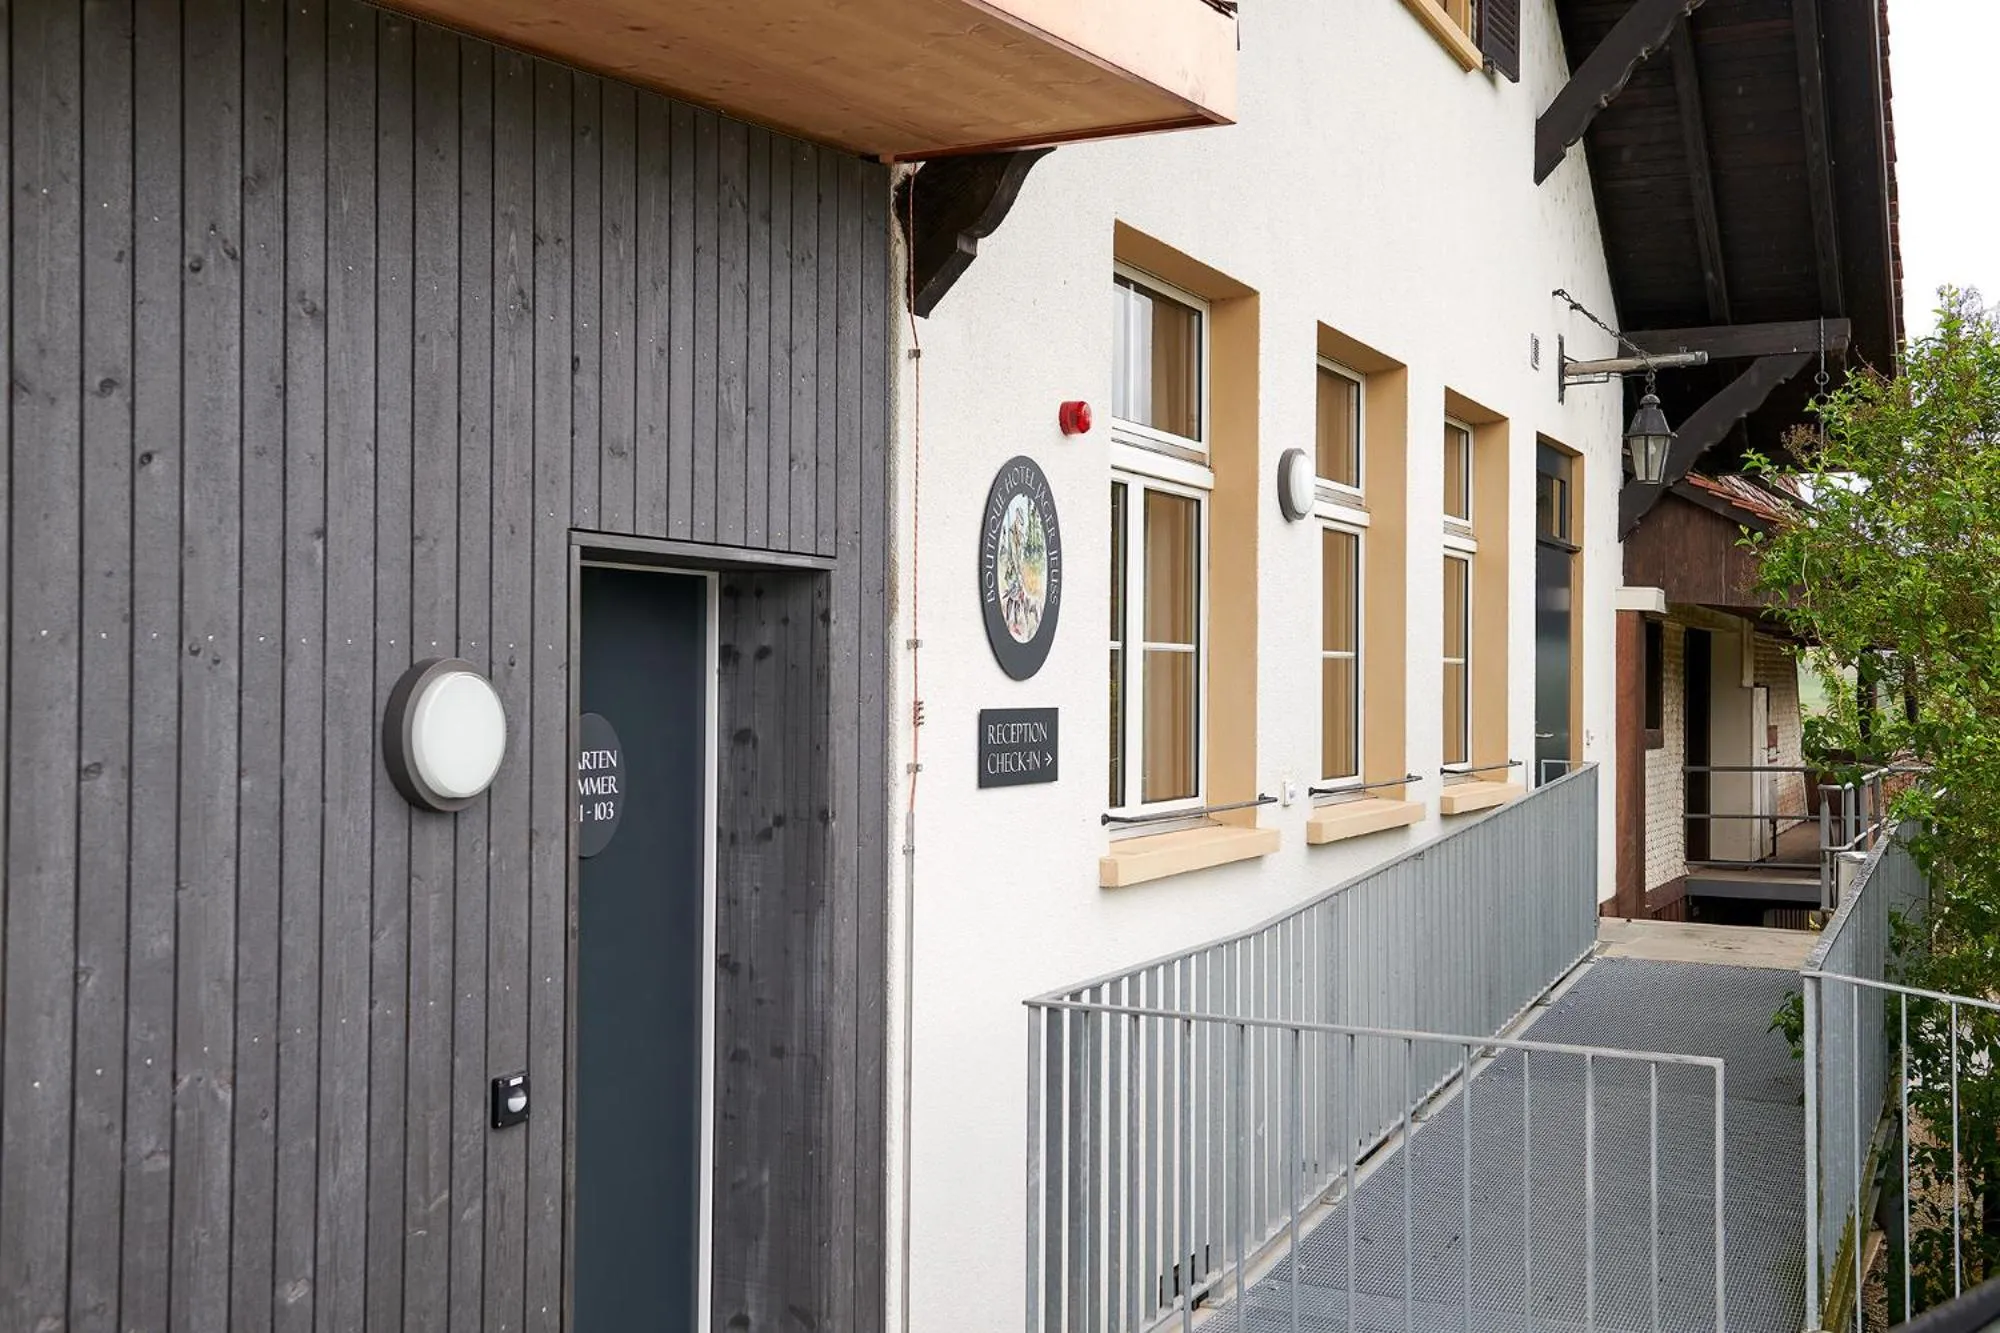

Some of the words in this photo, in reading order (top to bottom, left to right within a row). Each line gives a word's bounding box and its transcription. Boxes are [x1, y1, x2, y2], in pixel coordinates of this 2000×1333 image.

[986, 487, 1007, 603] BOUTIQUE
[1004, 466, 1035, 492] HOTEL
[987, 722, 1048, 744] RECEPTION
[987, 751, 1041, 774] CHECK-IN
[594, 801, 614, 821] 103
